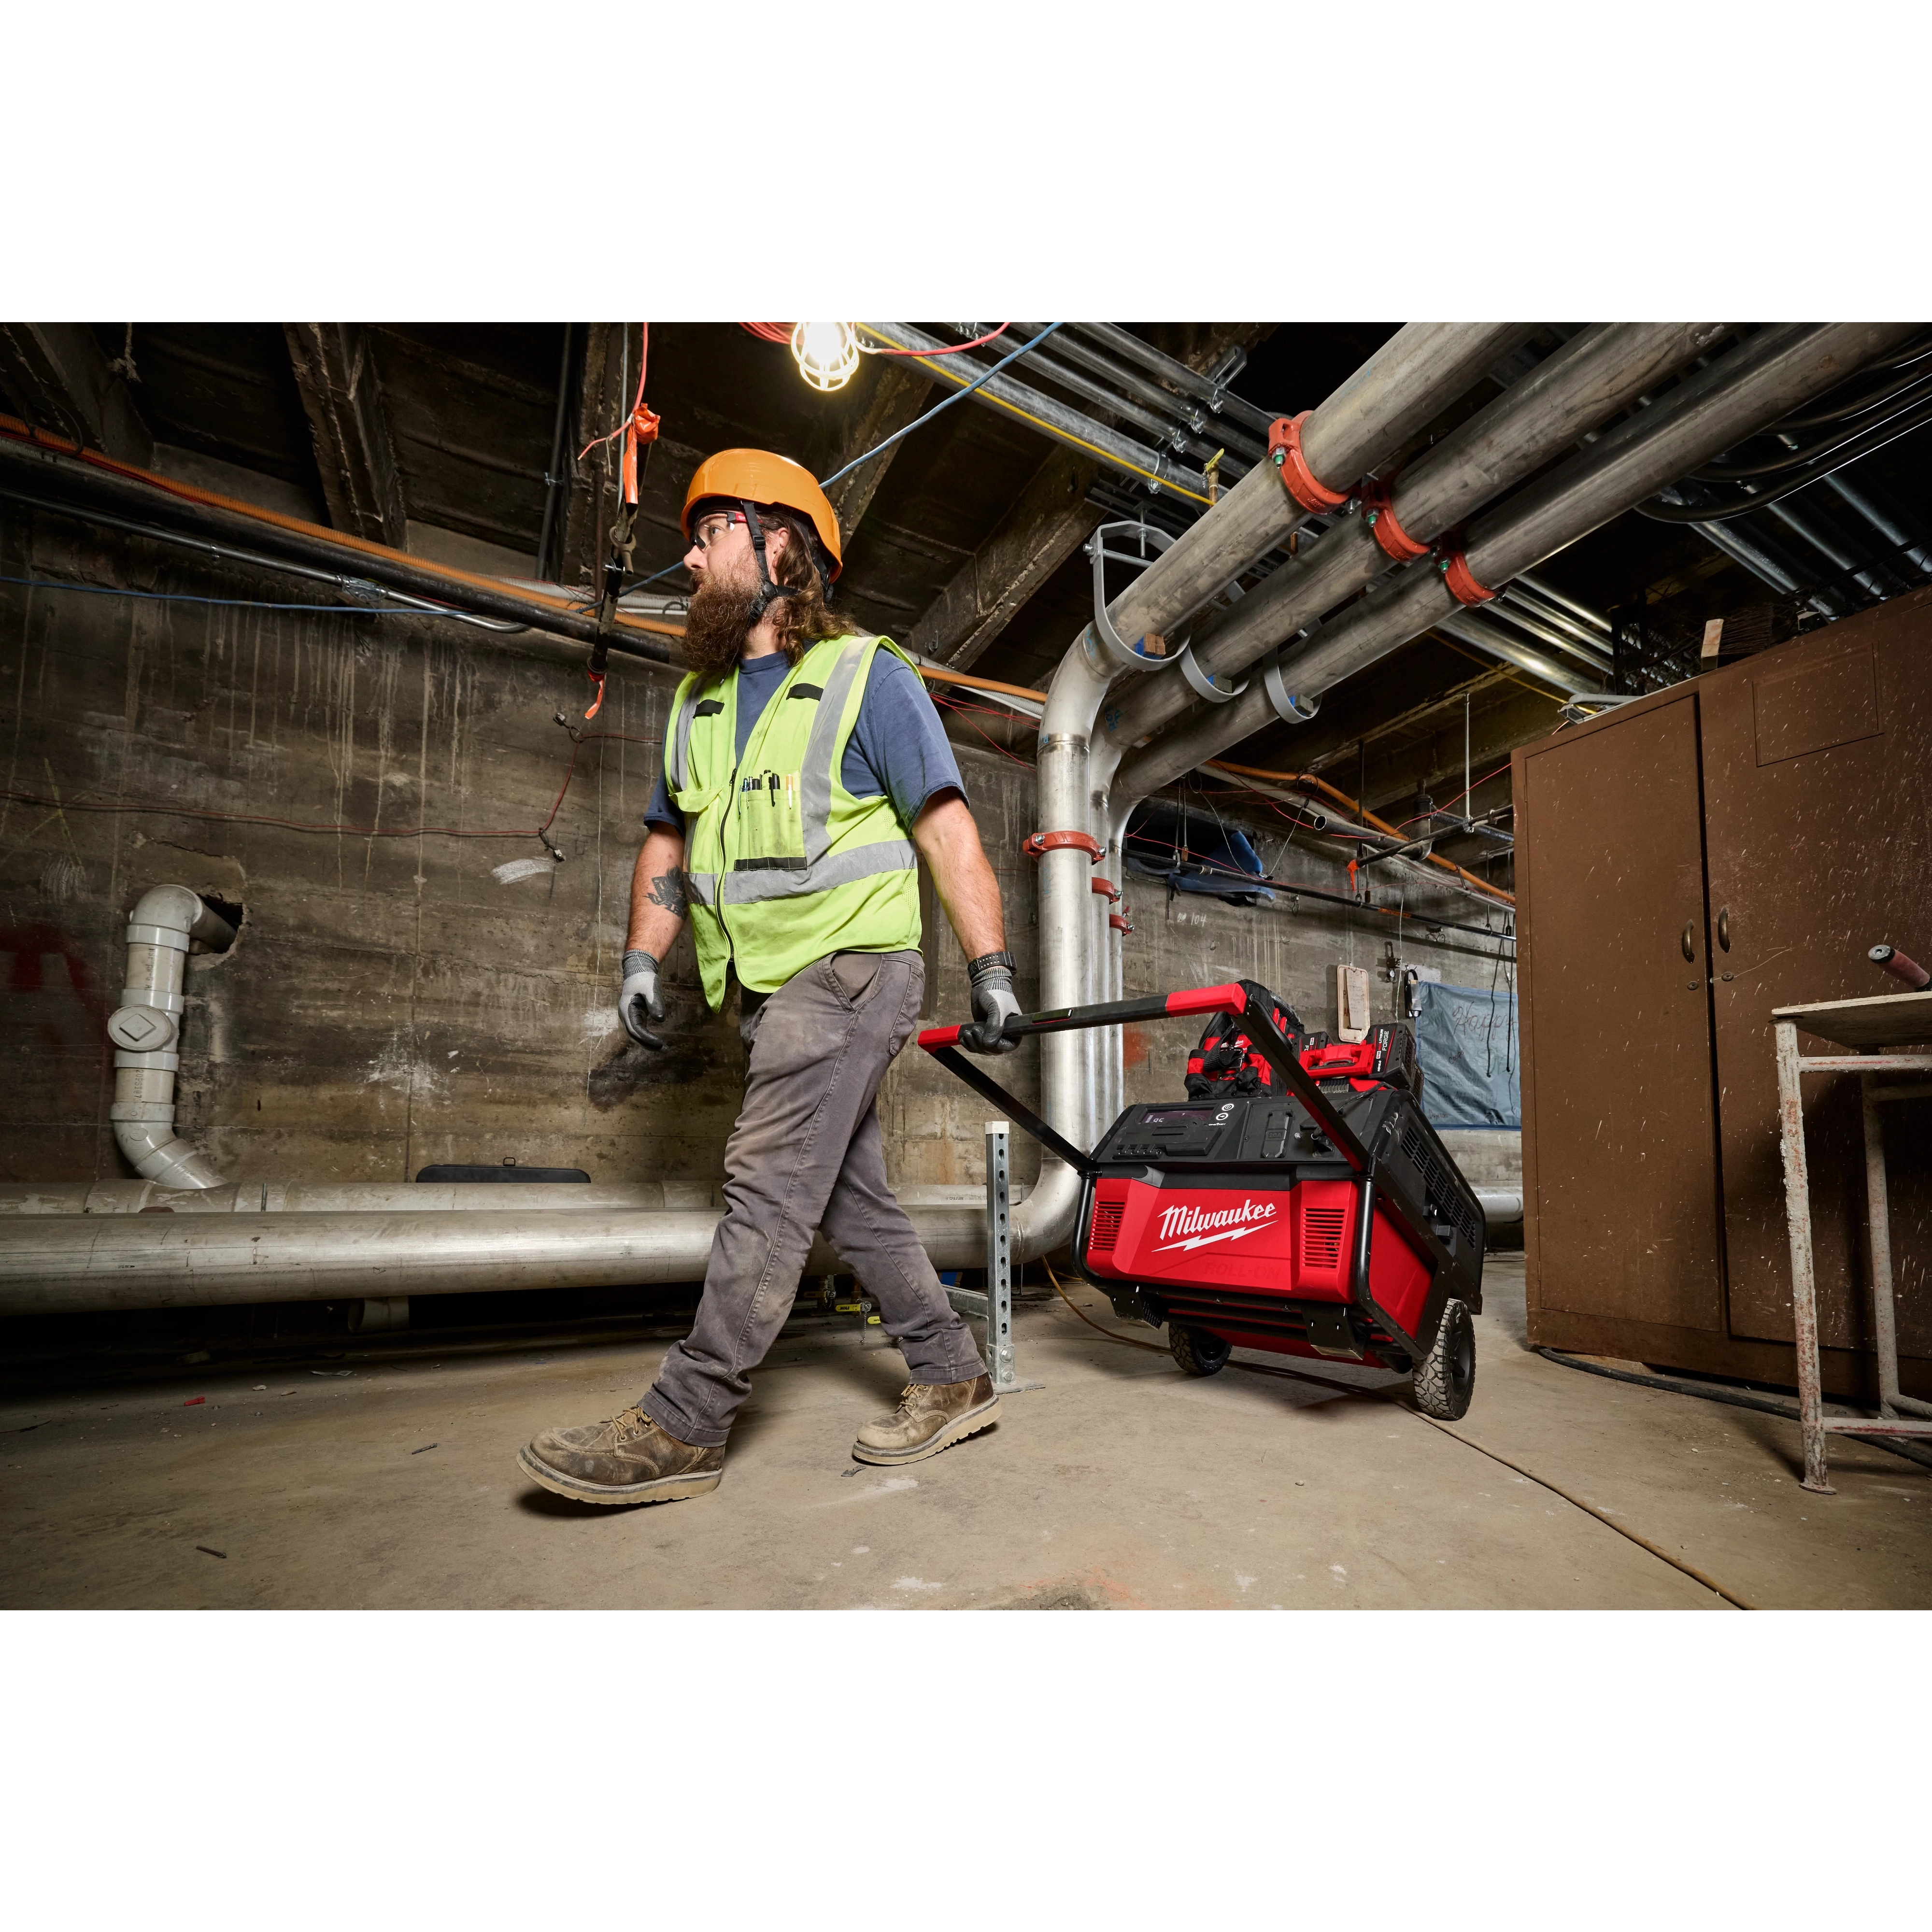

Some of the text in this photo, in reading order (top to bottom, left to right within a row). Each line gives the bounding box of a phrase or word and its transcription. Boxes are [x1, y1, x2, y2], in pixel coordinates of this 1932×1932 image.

[1191, 912, 1208, 927] 104
[1452, 1001, 1518, 1041] Happy
[1157, 1199, 1277, 1240] Milwaukee
[1204, 1262, 1281, 1280] ROLL-ON
